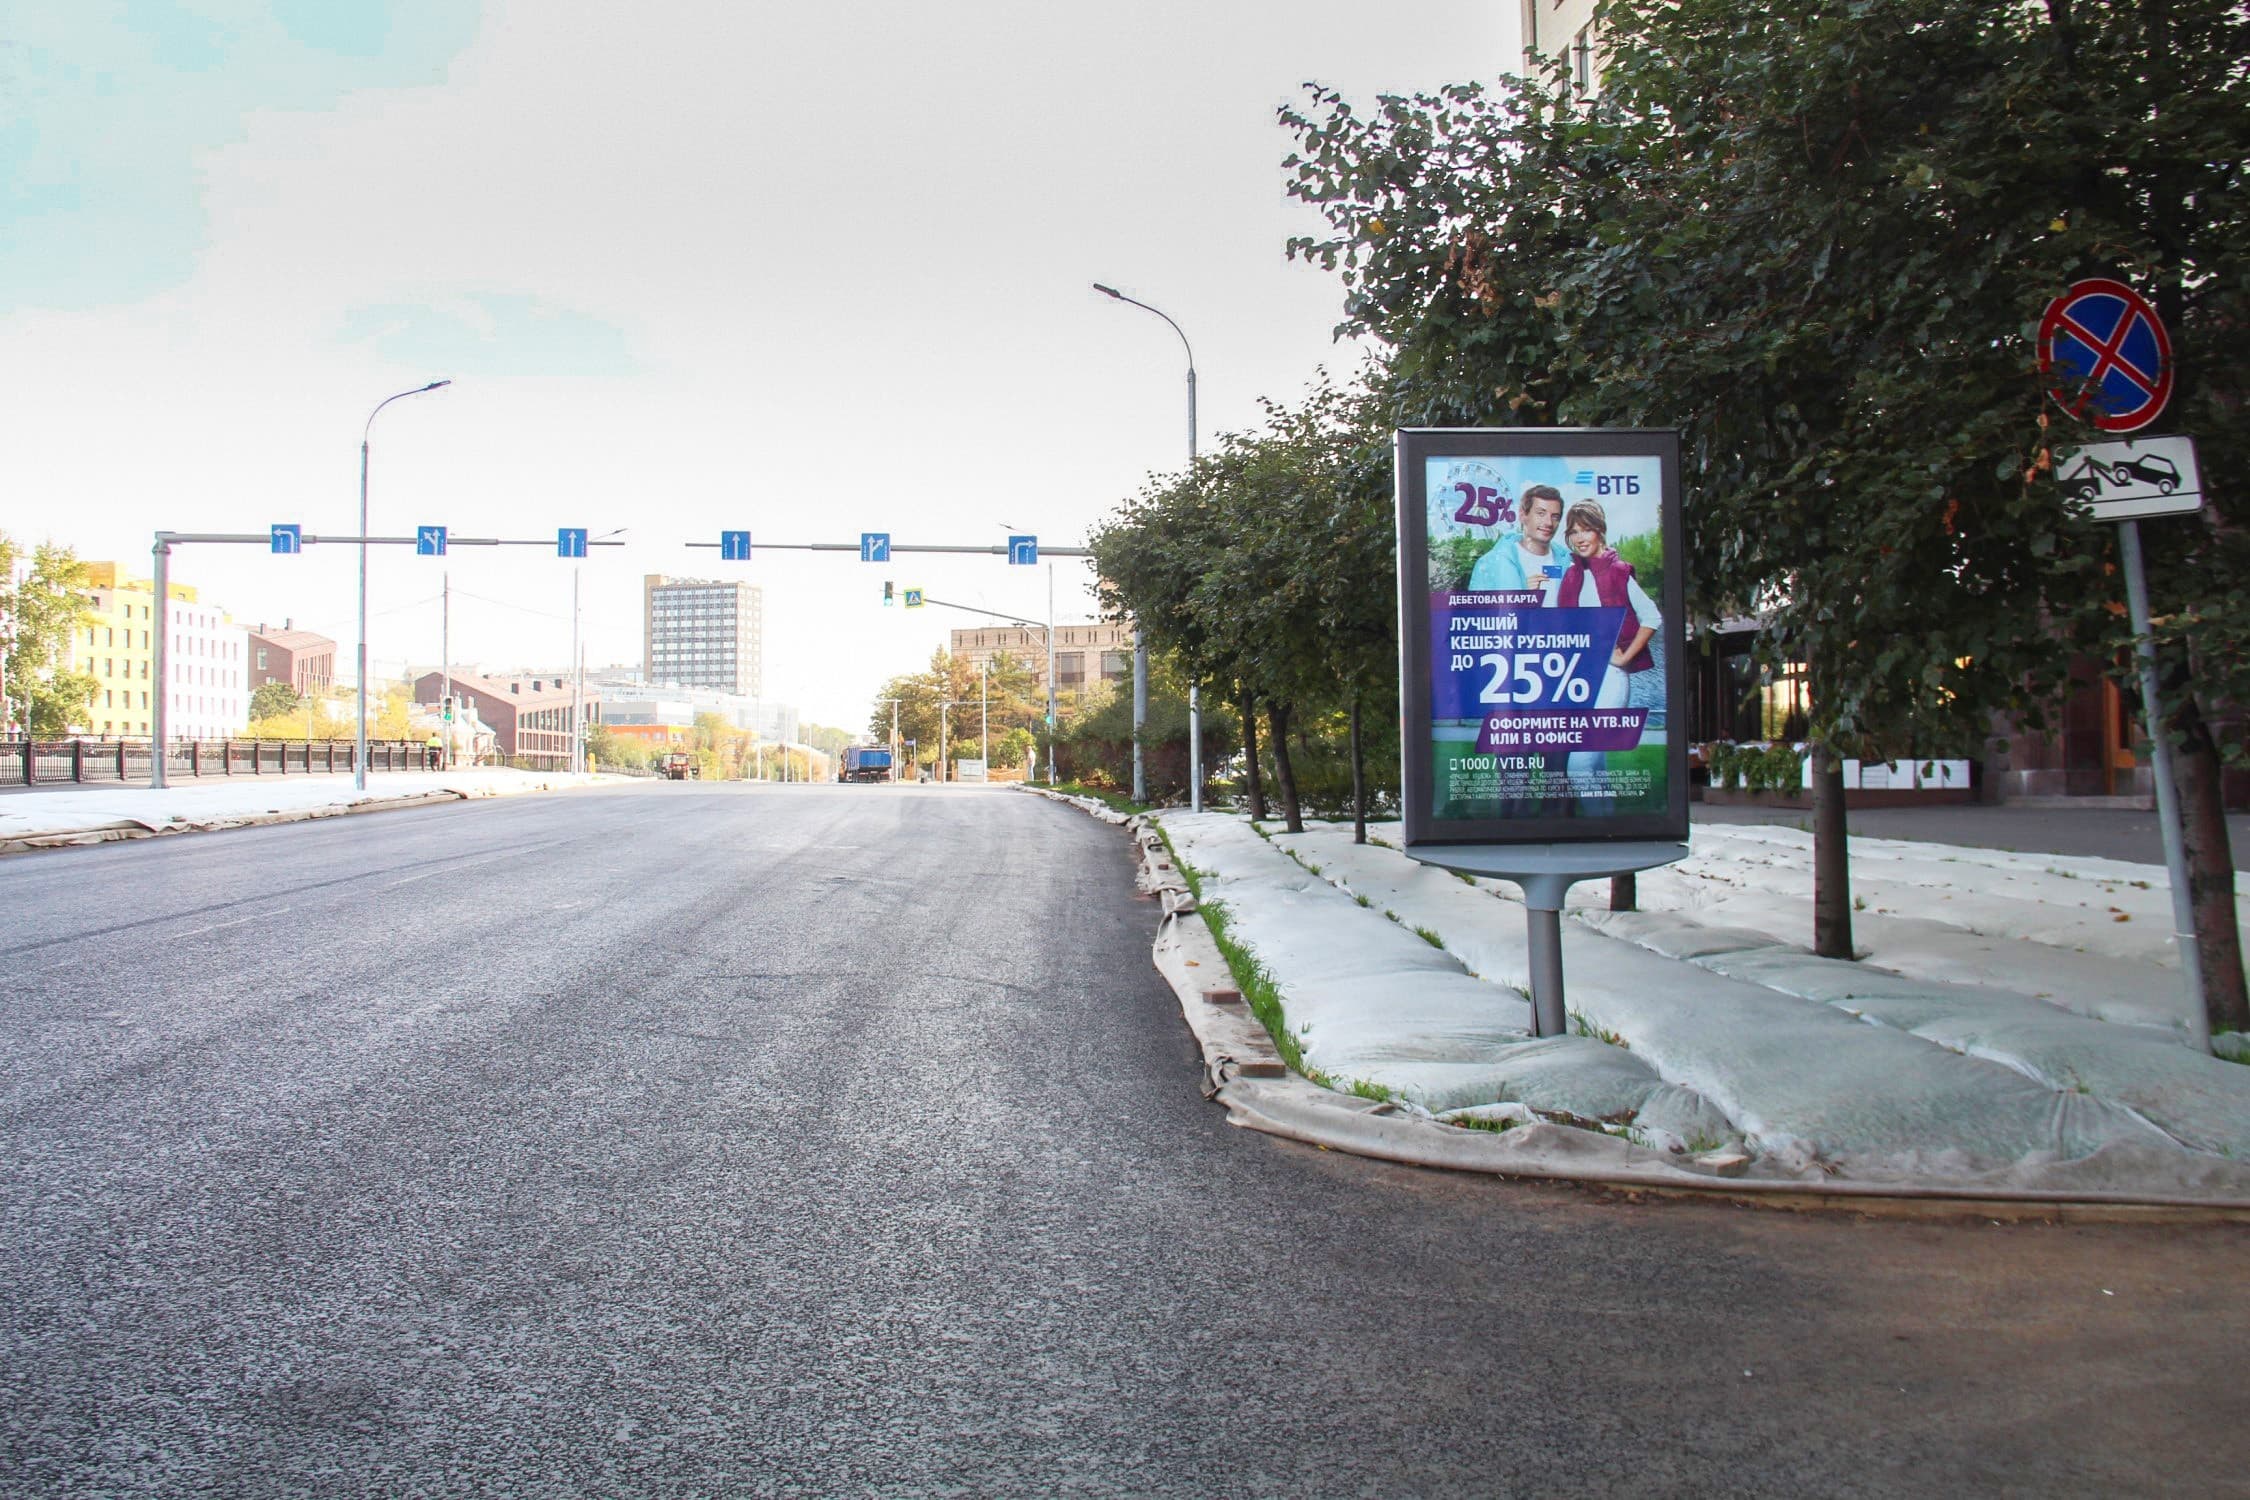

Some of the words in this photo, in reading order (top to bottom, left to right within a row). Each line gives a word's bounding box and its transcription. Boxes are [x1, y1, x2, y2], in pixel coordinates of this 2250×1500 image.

[1597, 475, 1640, 495] ВТБ
[1454, 482, 1516, 527] 25%
[1449, 594, 1504, 606] ДЕБЕТОВАЯ
[1506, 594, 1538, 605] КАРТА
[1450, 613, 1517, 631] ЛУЧШИЙ
[1451, 635, 1513, 650] КЕШБЭК
[1517, 634, 1590, 649] РУБЛЯМИ
[1451, 654, 1473, 672] ДО
[1479, 653, 1590, 704] 25%
[1489, 716, 1567, 731] ОФОРМИТЕ
[1570, 716, 1588, 729] НА
[1592, 715, 1639, 728] VTB.RU
[1490, 732, 1519, 745] ИЛИ
[1523, 733, 1531, 744] В
[1535, 731, 1583, 744] ОФИСЕ
[1460, 757, 1490, 770] 1000
[1500, 756, 1545, 769] VTB.RU
